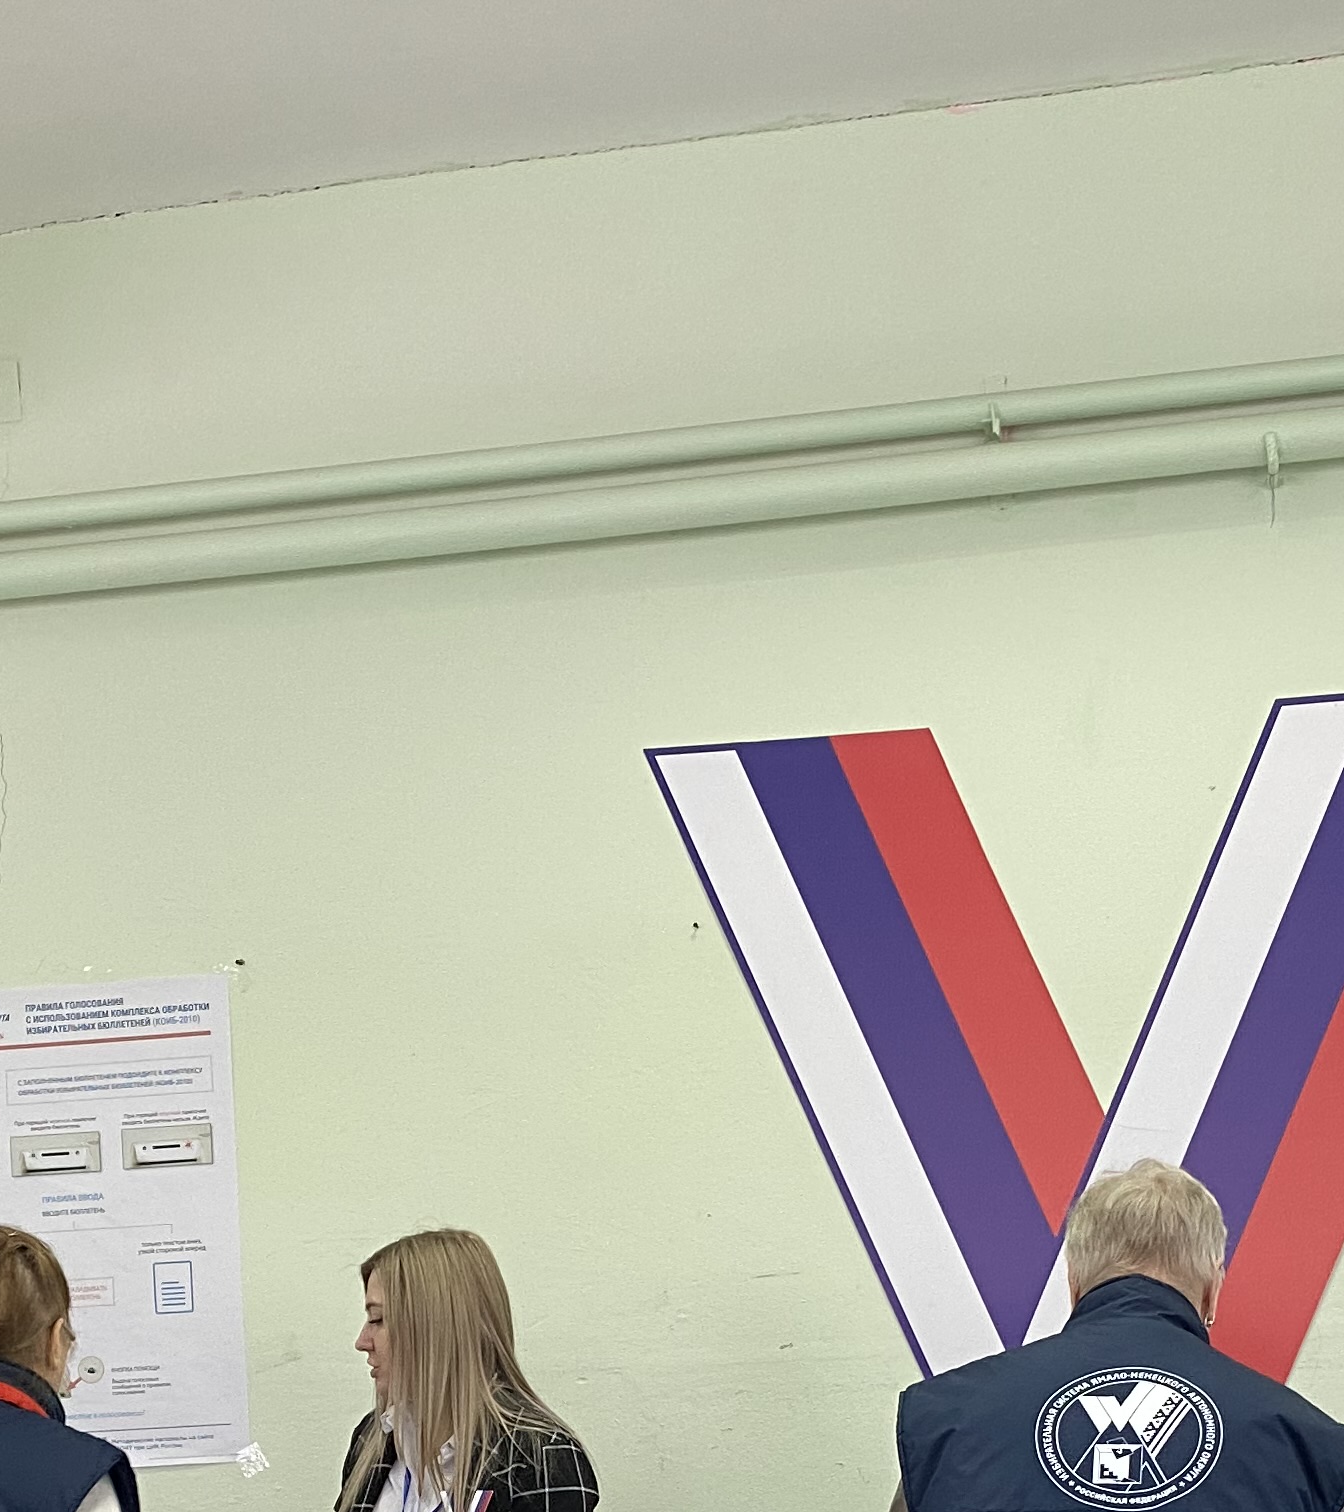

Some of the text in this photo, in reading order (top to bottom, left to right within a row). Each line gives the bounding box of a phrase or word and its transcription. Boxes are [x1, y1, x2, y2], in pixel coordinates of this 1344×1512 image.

[25, 997, 124, 1013] ПРАВИЛА ГОЛОСОВАНИЯ
[26, 1002, 210, 1024] С ИСПОЛЬЗОВАНИЕМ КОМПЛЕКСА ОБРАБОТКИ
[26, 1023, 96, 1035] ИЗБИРАТЕЛЬНЫХ
[97, 1018, 151, 1030] БЮЛЛЕТЕНЕЙ
[1042, 1371, 1216, 1482] ИЗБИРАТЕЛЬНАЯ СИСТЕМА ЯМАЛО-НЕНЕЦКОГО АВТОНОМНОГО ОКРУГА
